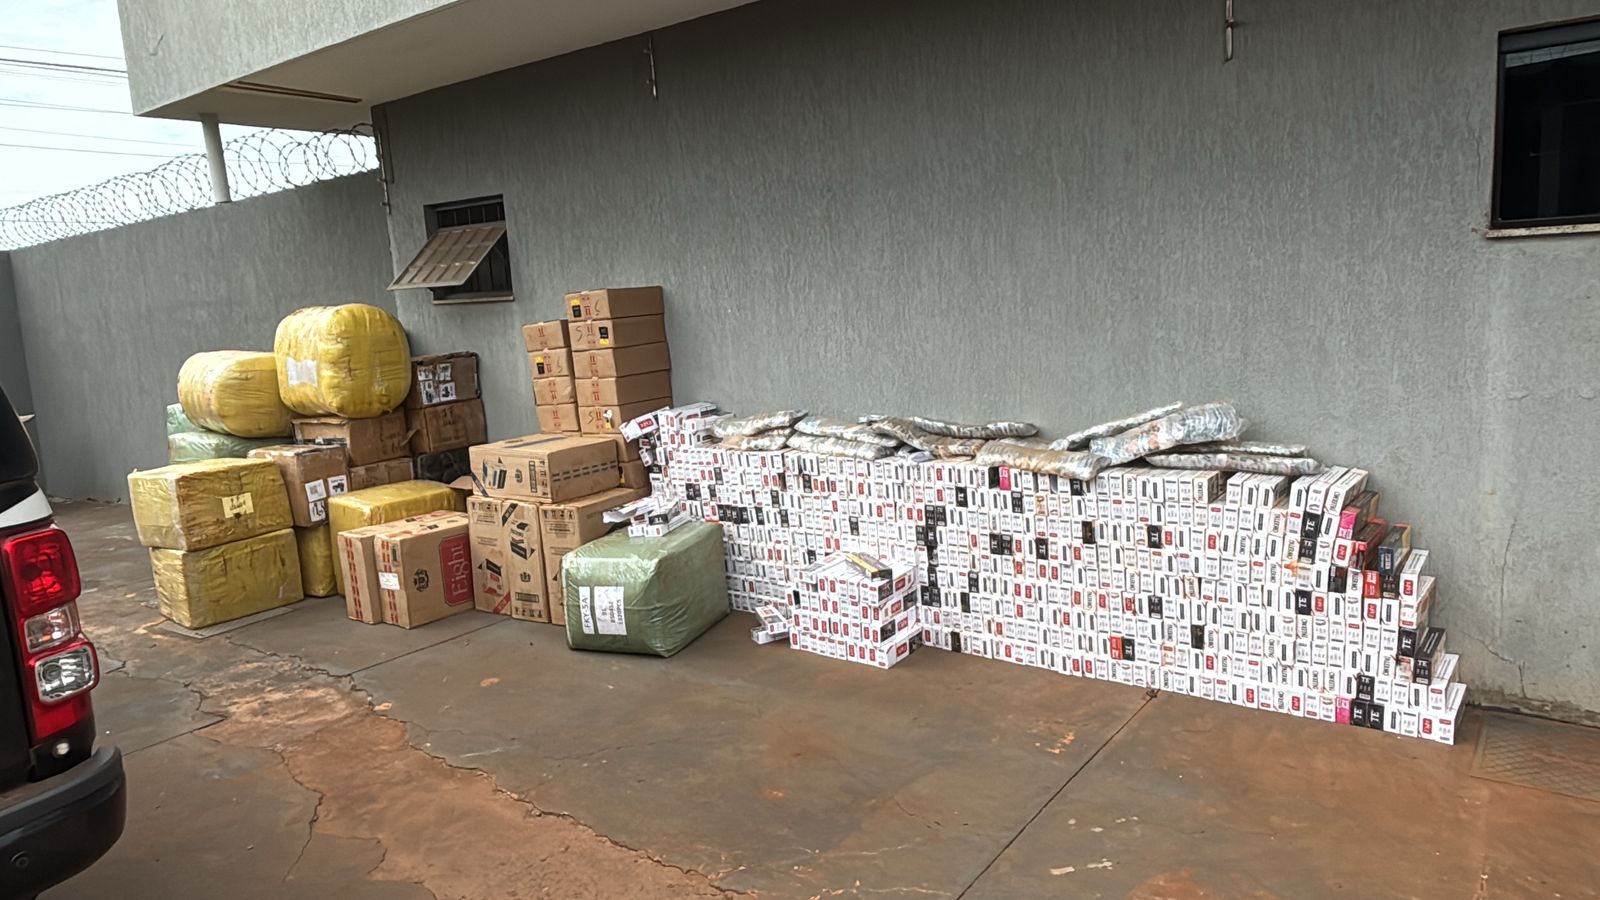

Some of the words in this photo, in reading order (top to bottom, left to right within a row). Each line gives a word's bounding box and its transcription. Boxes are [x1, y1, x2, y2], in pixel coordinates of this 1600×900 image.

[1306, 518, 1316, 532] TE
[448, 542, 470, 596] Eight
[1298, 596, 1308, 608] TE
[1402, 637, 1411, 649] TE
[1354, 707, 1363, 719] TE
[1370, 709, 1380, 722] TE
